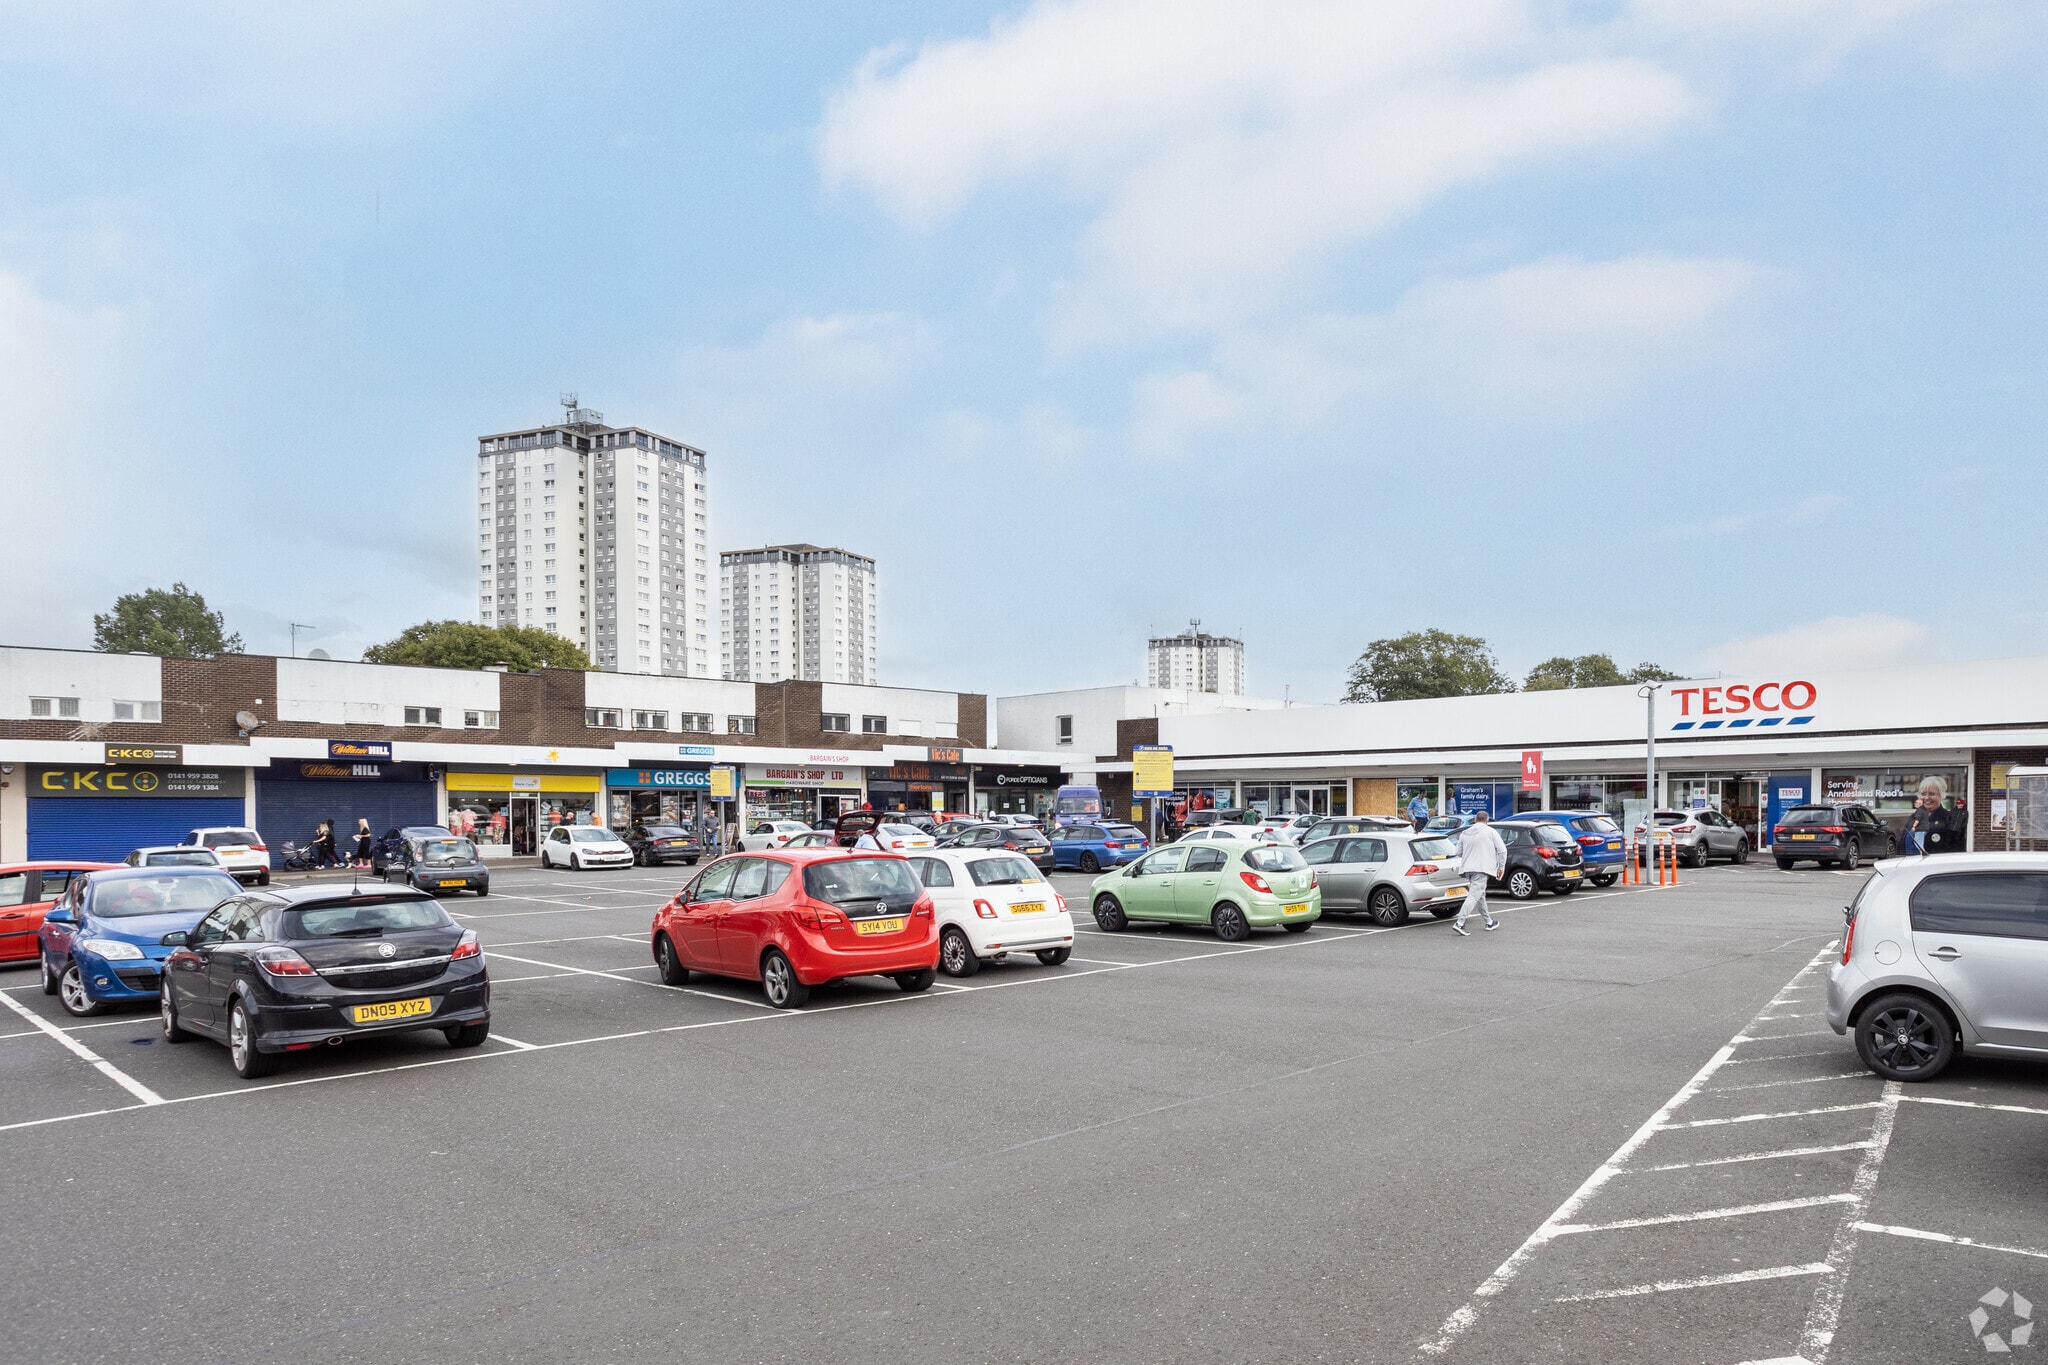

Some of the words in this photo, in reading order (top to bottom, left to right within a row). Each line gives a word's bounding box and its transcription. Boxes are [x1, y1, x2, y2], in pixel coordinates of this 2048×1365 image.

[1671, 681, 1817, 716] TESCO
[331, 743, 368, 756] William
[368, 745, 390, 755] HILL
[686, 747, 714, 755] GREGGS
[352, 764, 381, 776] HILL
[766, 769, 805, 780] BARGAIN'S
[807, 770, 825, 780] SHOP
[831, 771, 844, 780] LTD
[1827, 780, 1858, 789] Serving
[1827, 789, 1874, 798] Anniesland
[1875, 789, 1904, 797] Road's
[862, 922, 880, 932] SY14
[360, 1004, 397, 1019] DN09
[400, 1000, 426, 1014] XYZ
